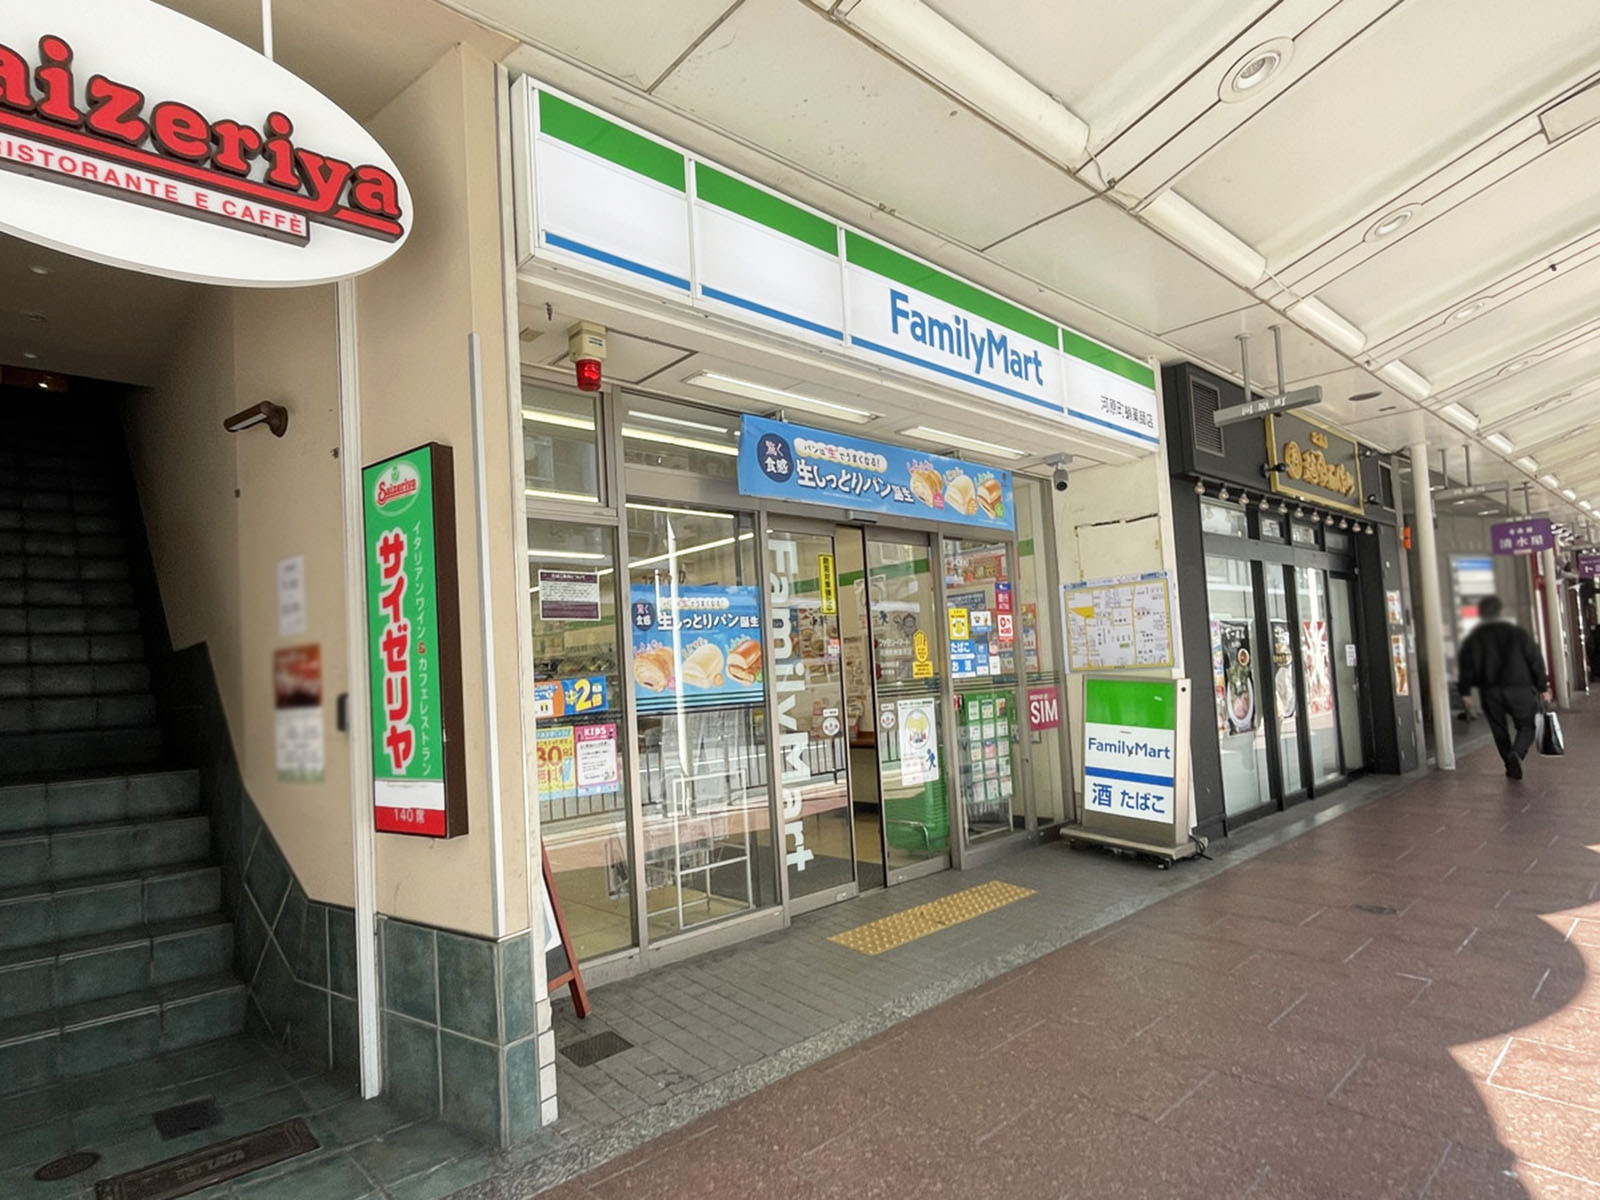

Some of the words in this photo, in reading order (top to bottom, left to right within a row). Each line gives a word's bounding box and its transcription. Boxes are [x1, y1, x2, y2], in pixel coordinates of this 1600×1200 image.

[0, 141, 178, 202] ISTORANTE
[195, 192, 209, 209] E
[221, 200, 303, 234] CAFFÈ
[889, 288, 1044, 387] FamilyMart
[378, 530, 413, 771] サイゼリヤ
[1030, 699, 1059, 724] SIM
[1087, 737, 1171, 760] FamilyMart
[1092, 782, 1113, 808] 酒
[1120, 789, 1166, 814] たばこ
